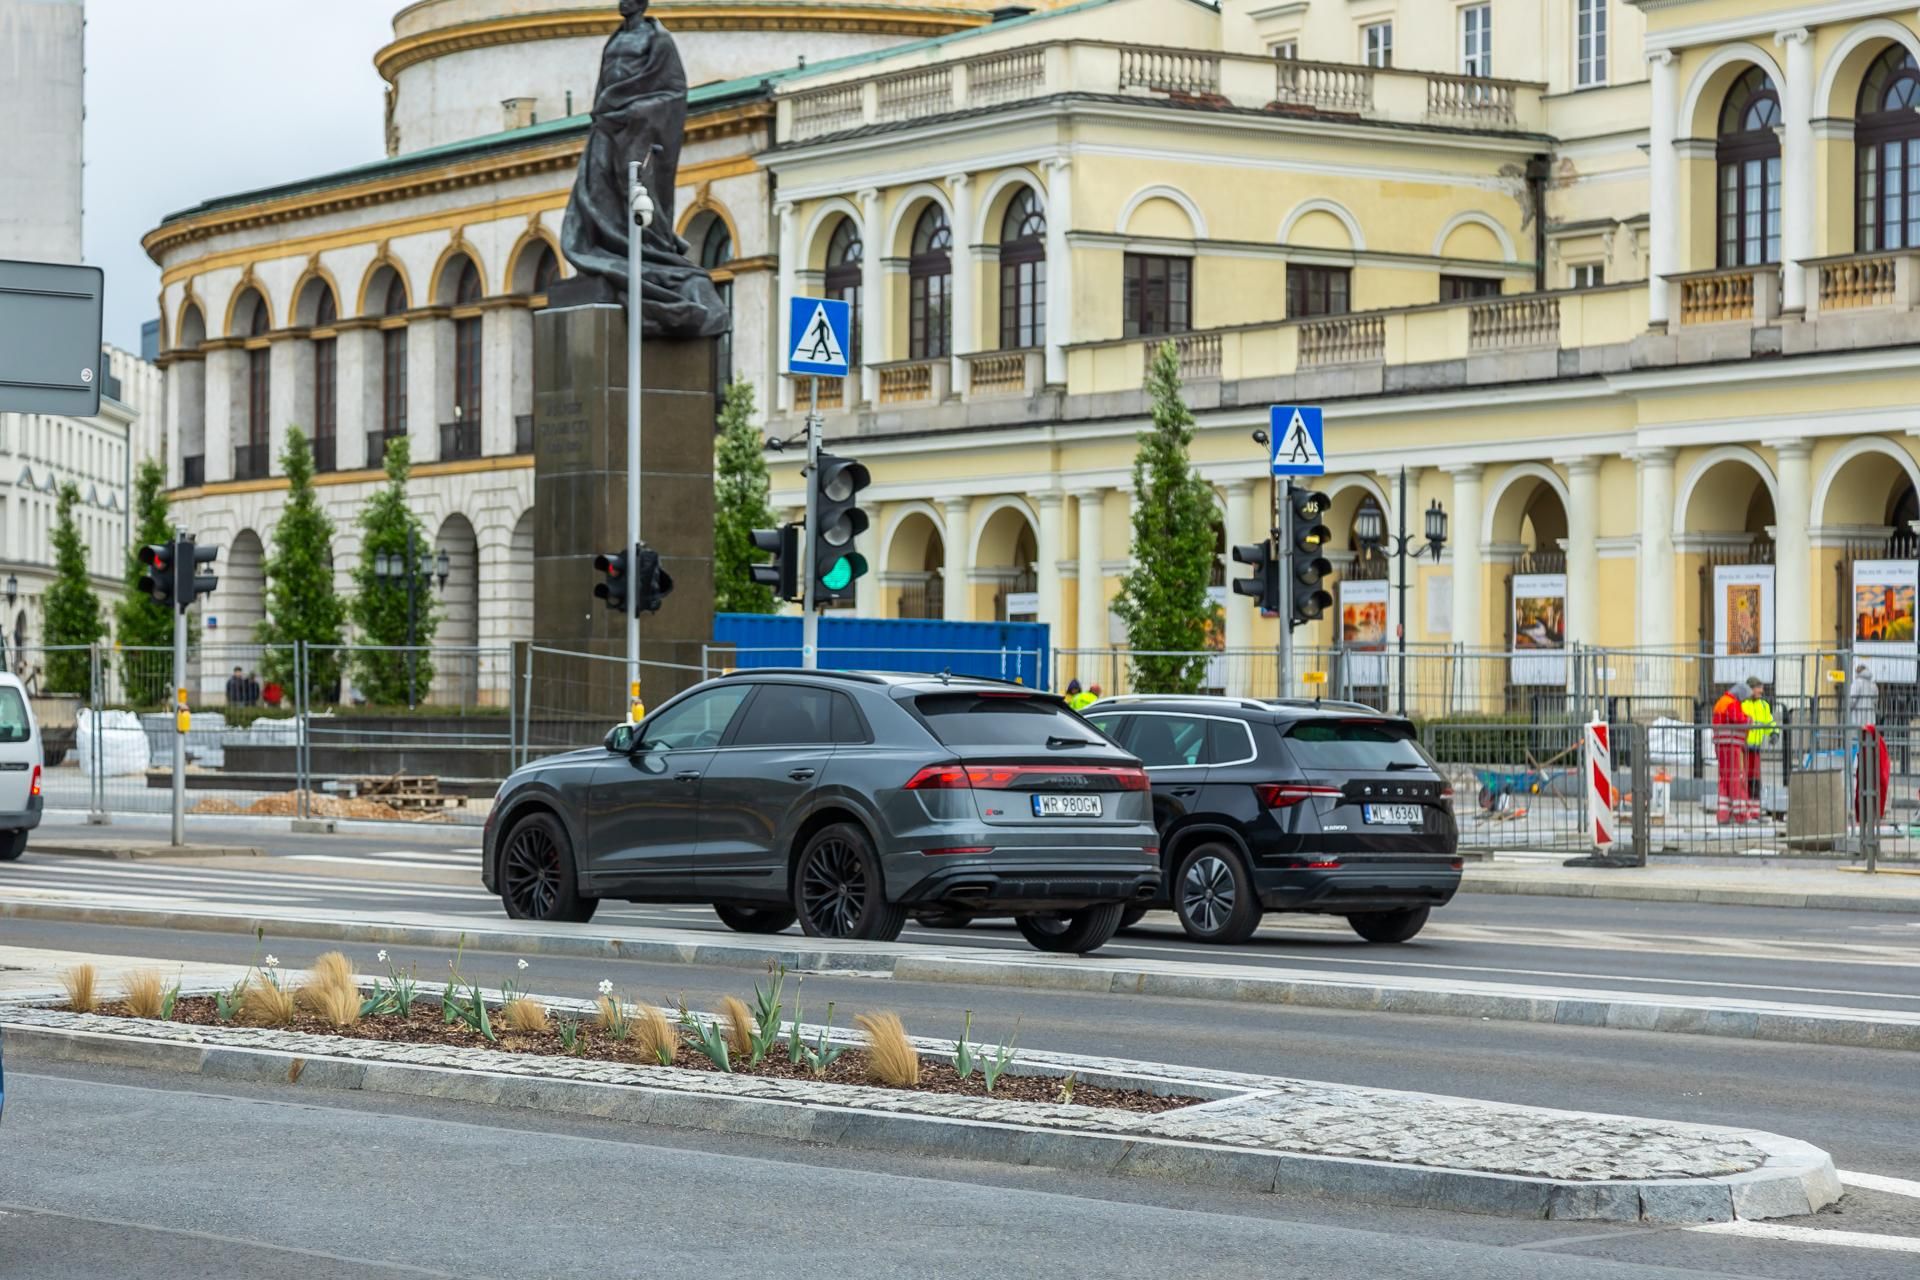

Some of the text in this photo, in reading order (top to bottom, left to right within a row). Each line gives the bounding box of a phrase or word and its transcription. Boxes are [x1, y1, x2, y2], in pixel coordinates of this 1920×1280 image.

[1042, 797, 1099, 812] WR 980GW
[1372, 806, 1420, 820] WL 1636V
